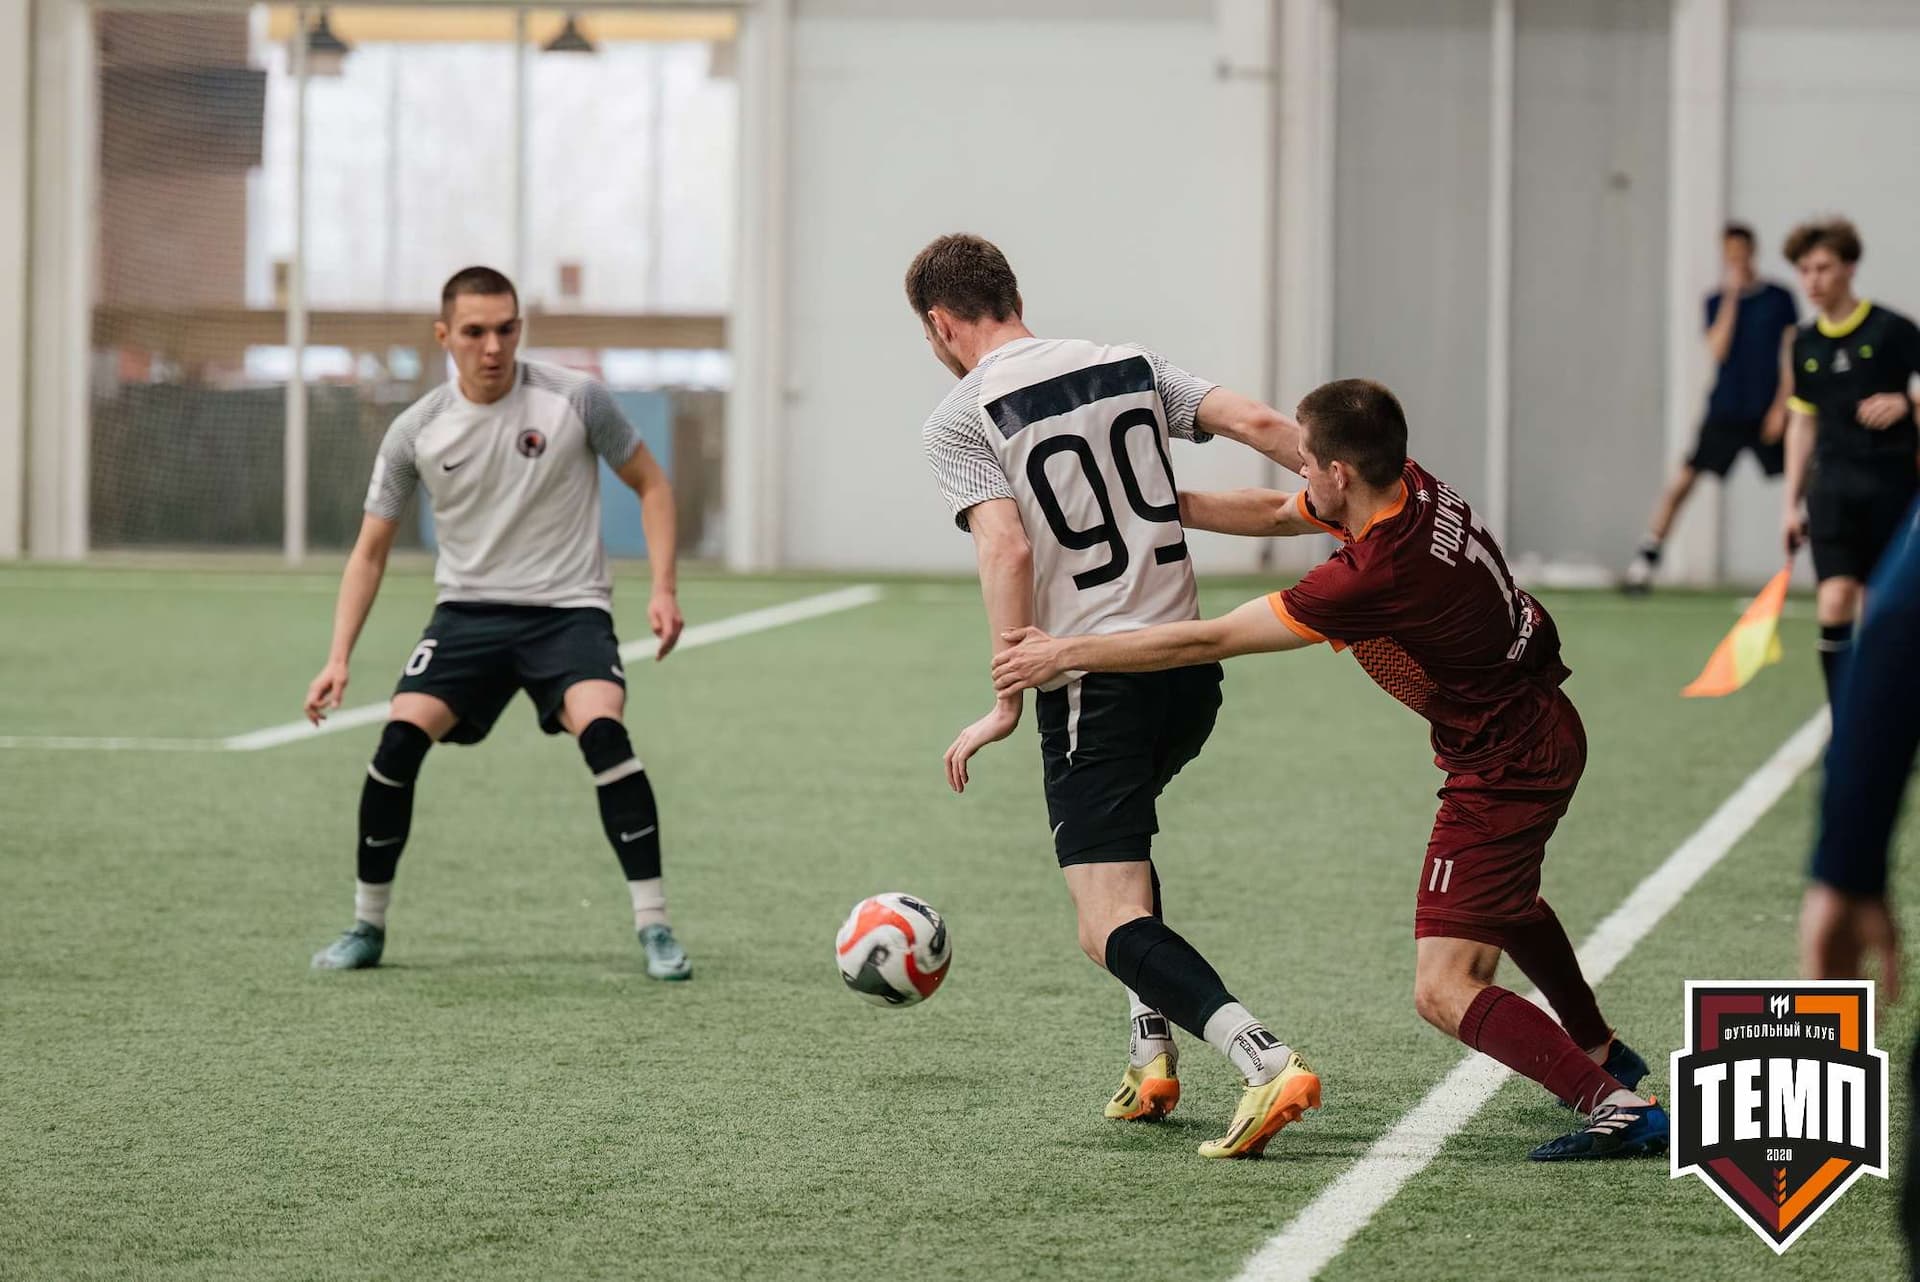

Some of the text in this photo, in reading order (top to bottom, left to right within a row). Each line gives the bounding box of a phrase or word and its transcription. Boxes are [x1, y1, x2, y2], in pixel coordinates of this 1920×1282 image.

[1026, 408, 1188, 591] 99
[405, 639, 438, 676] 6
[1429, 857, 1454, 894] 11
[1236, 1033, 1265, 1073] PEDESIGN
